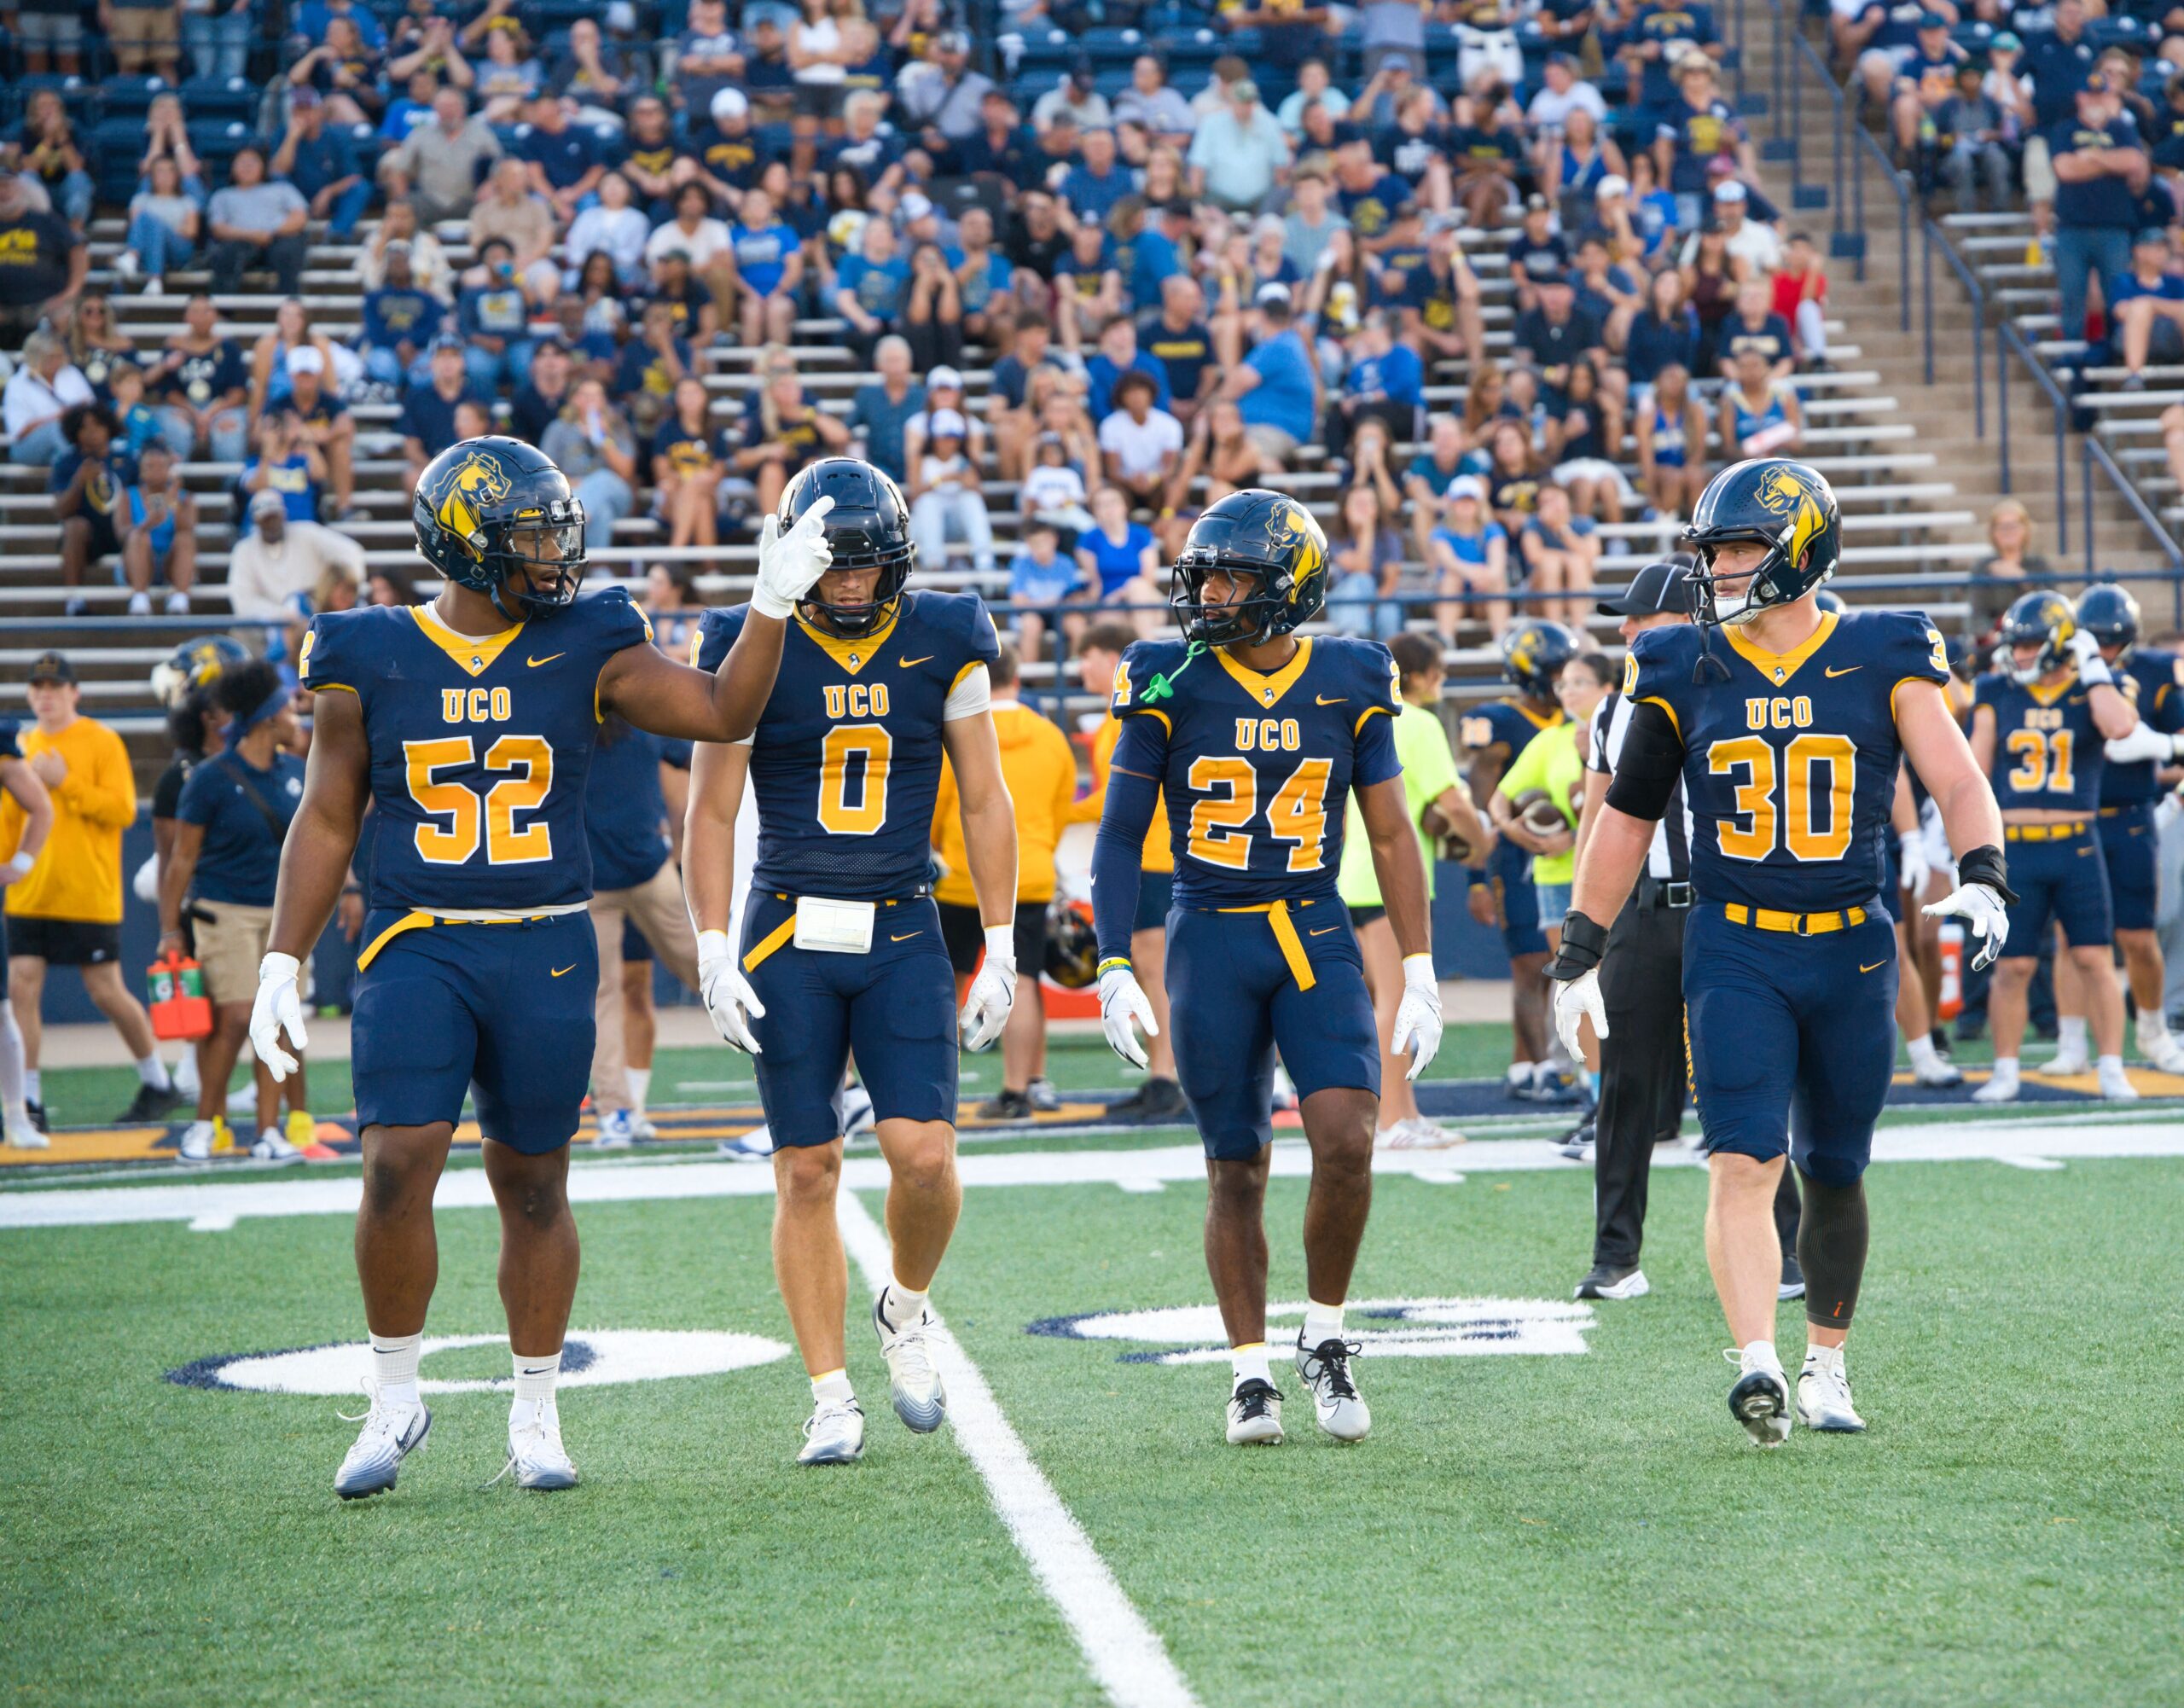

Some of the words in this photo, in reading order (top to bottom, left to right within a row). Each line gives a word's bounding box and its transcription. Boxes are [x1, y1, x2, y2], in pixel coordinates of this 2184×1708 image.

[441, 686, 512, 723] UCO
[822, 683, 890, 719] UCO
[1745, 695, 1814, 730] UCO
[1234, 717, 1301, 751] UCO
[816, 723, 892, 835] 0
[2007, 729, 2076, 793] 31
[402, 735, 554, 865] 52
[1186, 754, 1333, 873] 24
[1706, 733, 1858, 862] 30
[918, 885, 926, 894] M
